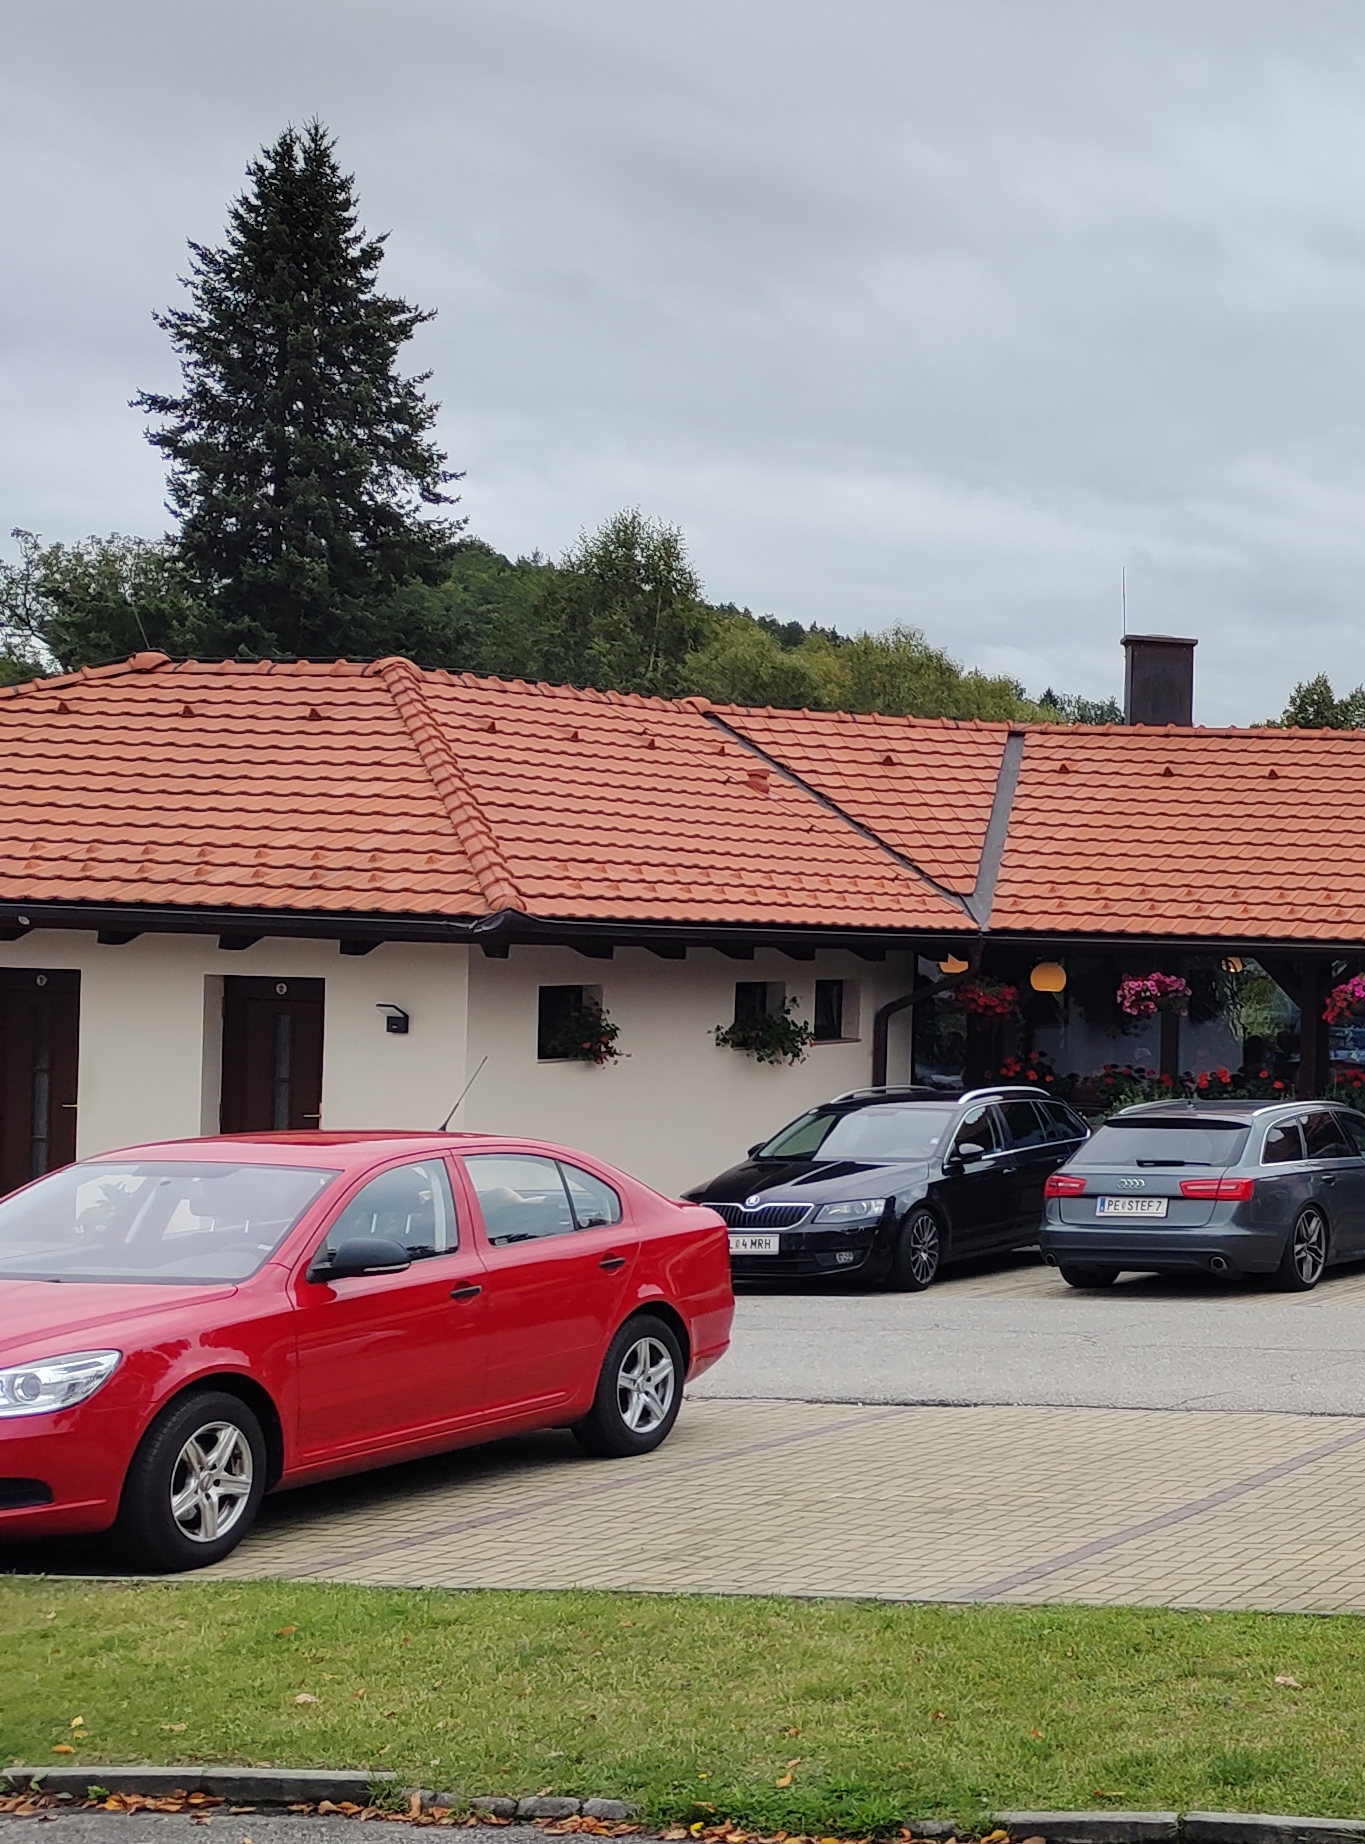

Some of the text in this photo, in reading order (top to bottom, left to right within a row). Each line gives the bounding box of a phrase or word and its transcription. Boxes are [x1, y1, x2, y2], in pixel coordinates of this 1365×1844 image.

[1107, 1199, 1163, 1212] PE STEF 7
[741, 1238, 748, 1250] 4
[750, 1238, 771, 1250] MRH
